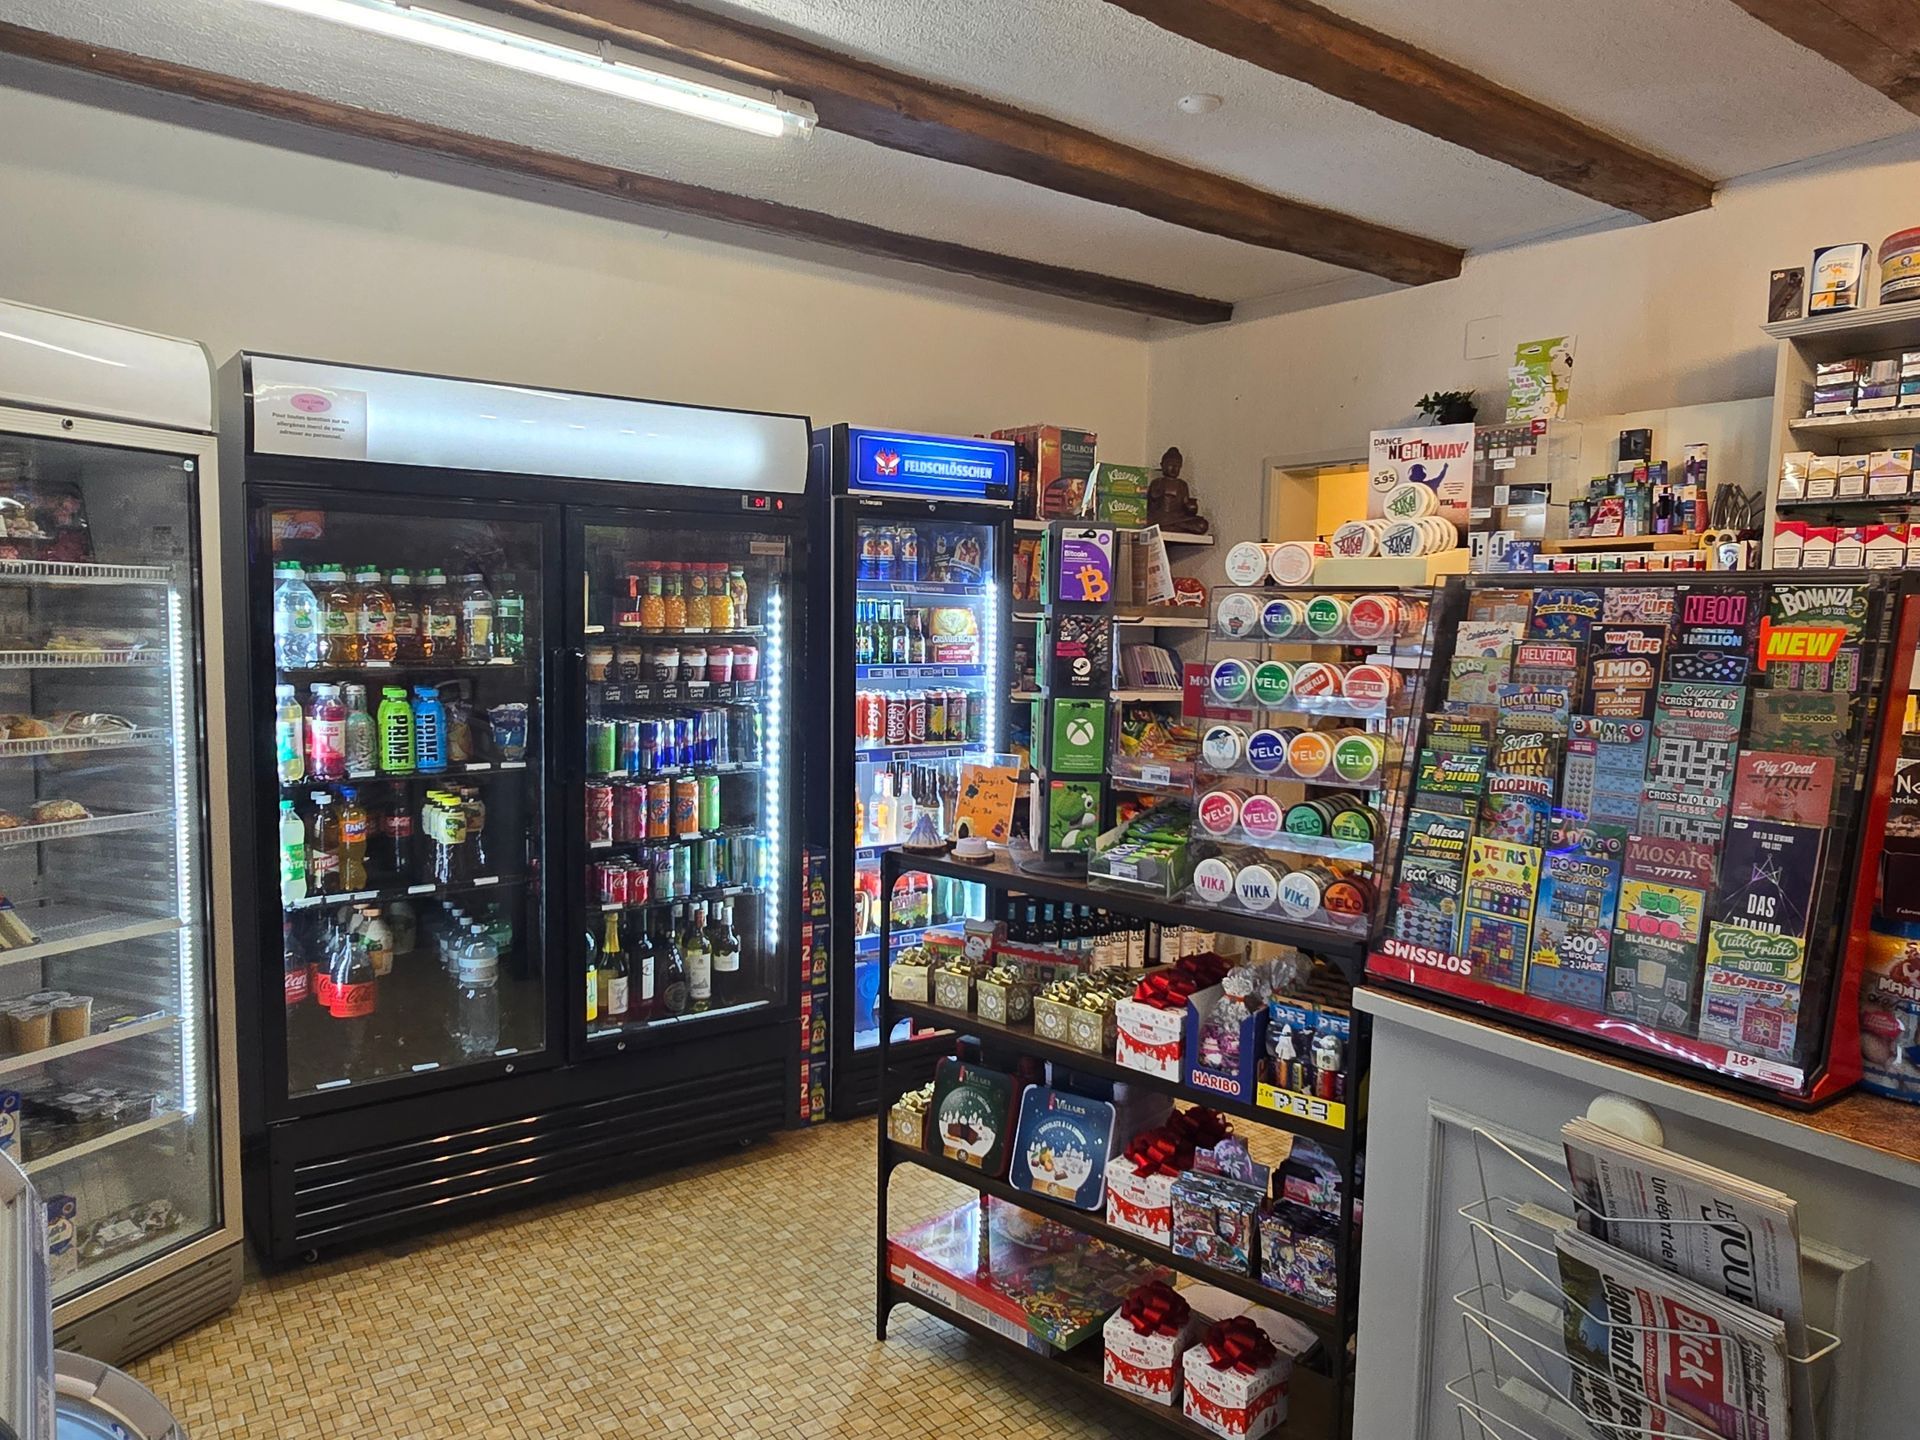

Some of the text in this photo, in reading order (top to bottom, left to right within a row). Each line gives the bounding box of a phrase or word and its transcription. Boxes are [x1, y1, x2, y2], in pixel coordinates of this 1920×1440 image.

[1062, 443, 1094, 453] GRILLBOX
[1374, 437, 1402, 446] DANCE
[904, 460, 993, 480] FELDSCHLÖSSCHEN
[1107, 469, 1140, 485] Kleenex
[1374, 474, 1396, 486] 5.95
[1107, 499, 1140, 515] Kleenex
[1064, 550, 1088, 558] Bitcoin
[1619, 594, 1640, 604] WIN
[1643, 600, 1674, 614] LIFE
[1779, 588, 1854, 617] BONANZA
[1264, 613, 1292, 623] VELO
[1309, 611, 1338, 621] VELO
[1684, 596, 1747, 625] NEON
[1466, 628, 1510, 641] Celebration
[1606, 633, 1626, 644] WIN
[1689, 633, 1743, 646] MILLION
[1629, 640, 1659, 653] LIFE
[1767, 632, 1837, 656] NEW
[1522, 648, 1573, 661] HELVETICA
[1609, 660, 1651, 678] MIO.
[1214, 675, 1247, 687] VELO
[1256, 677, 1289, 690] VELO
[1681, 685, 1722, 698] Super
[1501, 692, 1564, 708] LUCKY LINES
[887, 704, 896, 738] SUPER
[896, 707, 906, 736] BOCK
[916, 705, 926, 738] SUPER
[388, 713, 410, 765] PRIME
[1503, 733, 1545, 751] SUPER
[1250, 745, 1283, 758] VELO
[1291, 750, 1326, 762] VELO
[1336, 753, 1373, 766] VELO
[1499, 747, 1548, 766] LUCKY
[1752, 760, 1817, 776] Pig Deal
[1489, 777, 1549, 796] LOOPING
[1202, 805, 1234, 822] VELO
[1243, 812, 1278, 825] VELO
[1286, 818, 1322, 833] VELO
[1334, 824, 1369, 839] VELO
[1484, 844, 1527, 866] TETRIS
[1551, 856, 1611, 879] ROOFTOP
[1200, 875, 1226, 893] VIKA
[1242, 885, 1271, 899] VIKA
[1284, 886, 1311, 909] VIKA
[1326, 895, 1362, 911] VELO
[1747, 893, 1776, 917] DAS
[1625, 932, 1685, 954] BLACKJACK
[1718, 932, 1795, 956] Tutti Frutti
[802, 946, 811, 960] 2
[1383, 939, 1473, 976] SWISSLOS
[801, 1014, 810, 1029] 2
[1275, 1006, 1306, 1025] PEZ
[1317, 1015, 1350, 1035] PEZ
[1731, 1053, 1758, 1067] 18+
[801, 1083, 808, 1098] 2
[1193, 1070, 1240, 1095] HARIBO
[1055, 1097, 1087, 1115] VILLARS
[1273, 1090, 1329, 1121] PEZ
[1713, 1197, 1739, 1224] LE
[1651, 1176, 1677, 1262] Un départ de
[1611, 1330, 1640, 1371] auf
[1673, 1306, 1715, 1389] Blick
